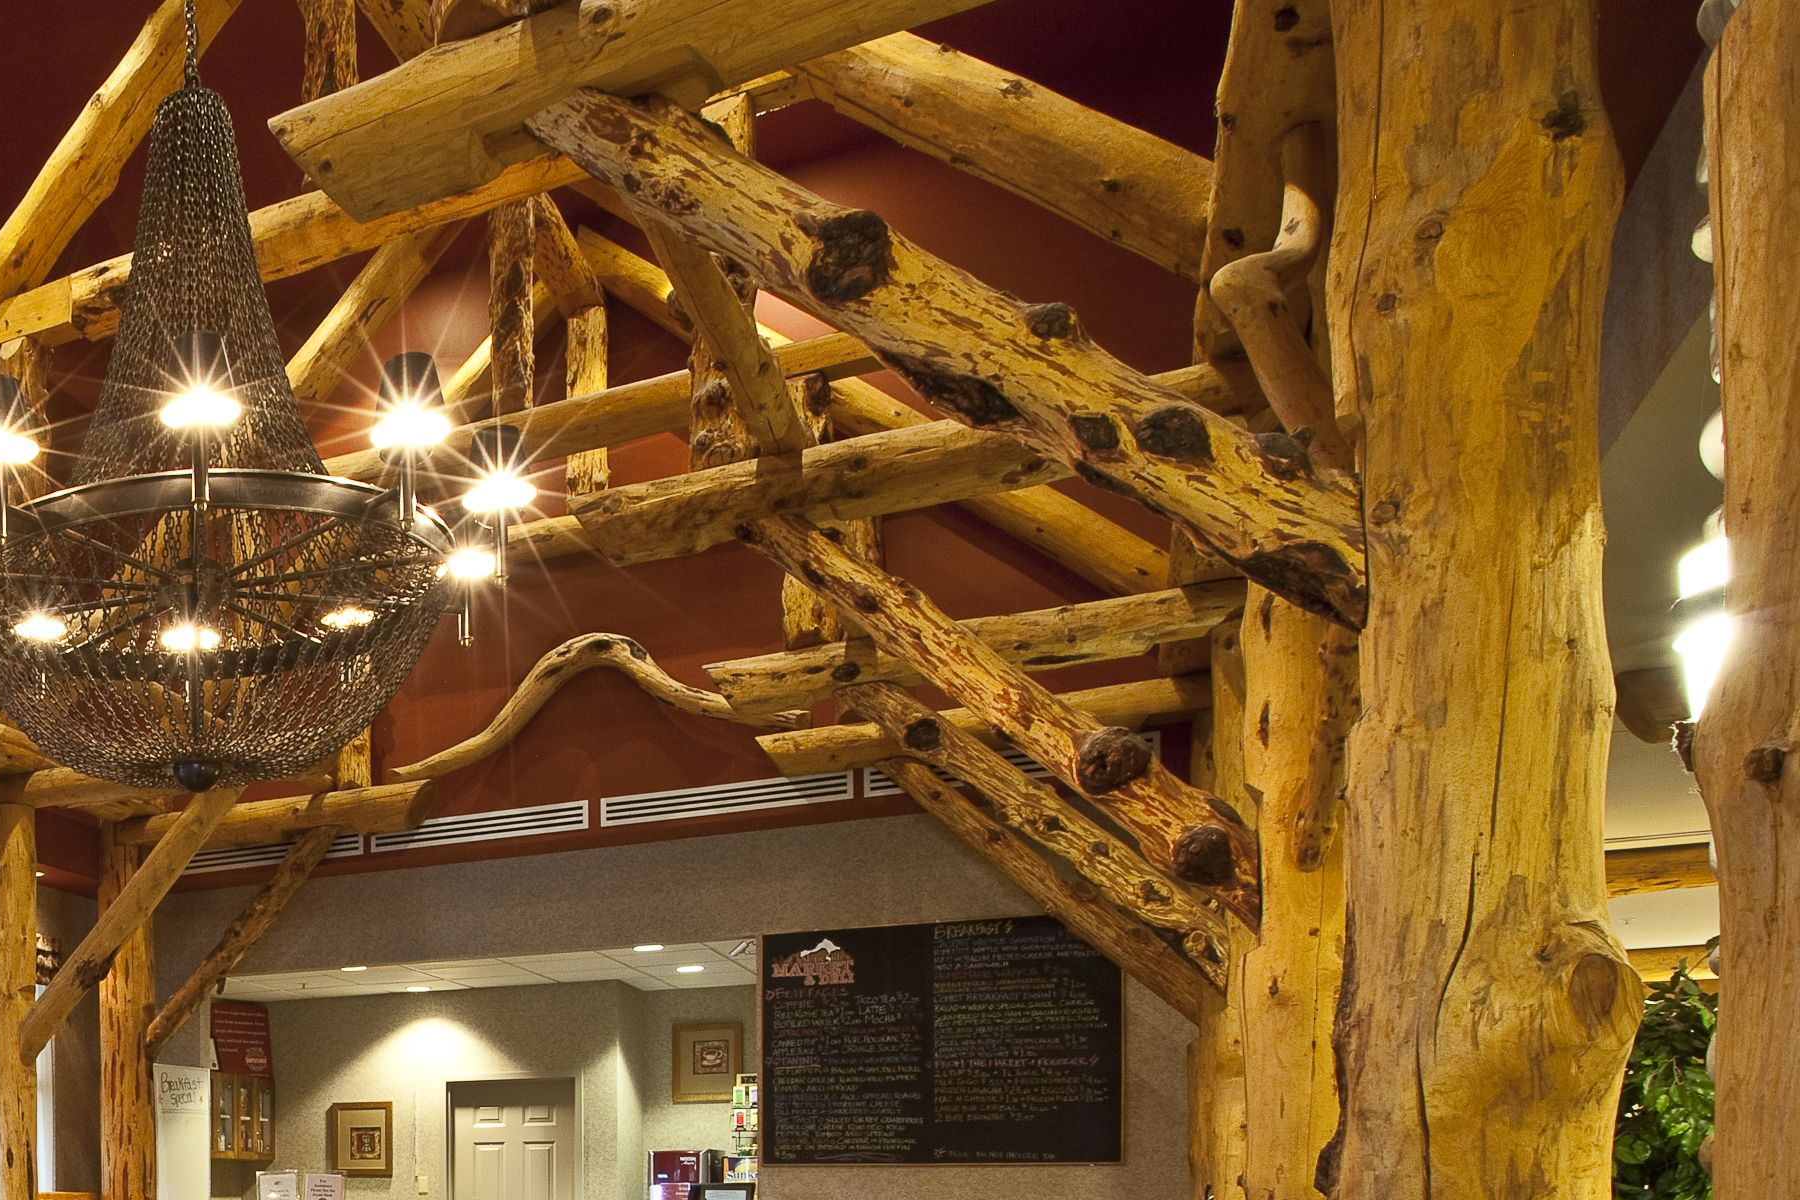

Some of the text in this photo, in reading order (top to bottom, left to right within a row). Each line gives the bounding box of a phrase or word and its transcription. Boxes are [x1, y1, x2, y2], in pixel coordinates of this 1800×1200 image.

[934, 921, 1002, 940] BREAKFAST
[772, 960, 854, 977] MARKET
[804, 973, 855, 985] & DELI
[858, 1004, 887, 1015] LATTE
[865, 1013, 897, 1024] MOCHA
[160, 1071, 203, 1094] Breakfast
